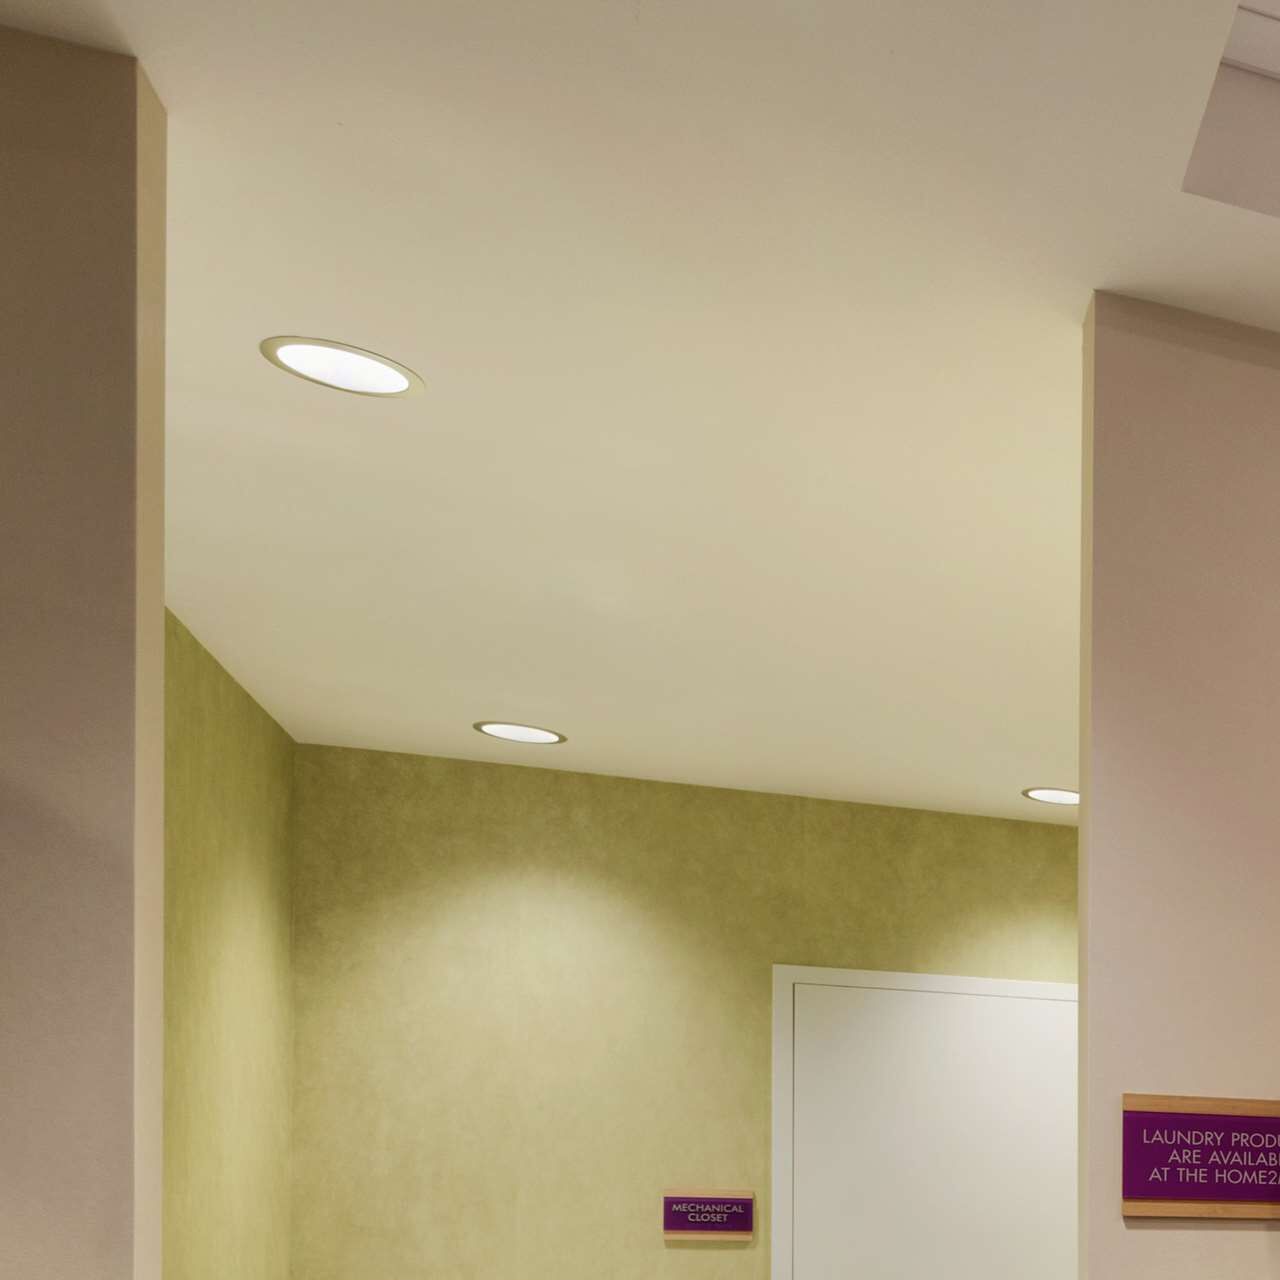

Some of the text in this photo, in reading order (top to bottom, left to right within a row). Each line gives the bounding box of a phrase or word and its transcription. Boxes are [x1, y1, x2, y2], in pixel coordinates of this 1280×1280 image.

[1143, 1129, 1224, 1146] LAUNDRY
[1168, 1150, 1200, 1164] ARE
[1149, 1168, 1168, 1181] AT
[1177, 1168, 1207, 1183] THE
[672, 1203, 744, 1213] MECHANICAL
[688, 1213, 728, 1222] CLOSET
